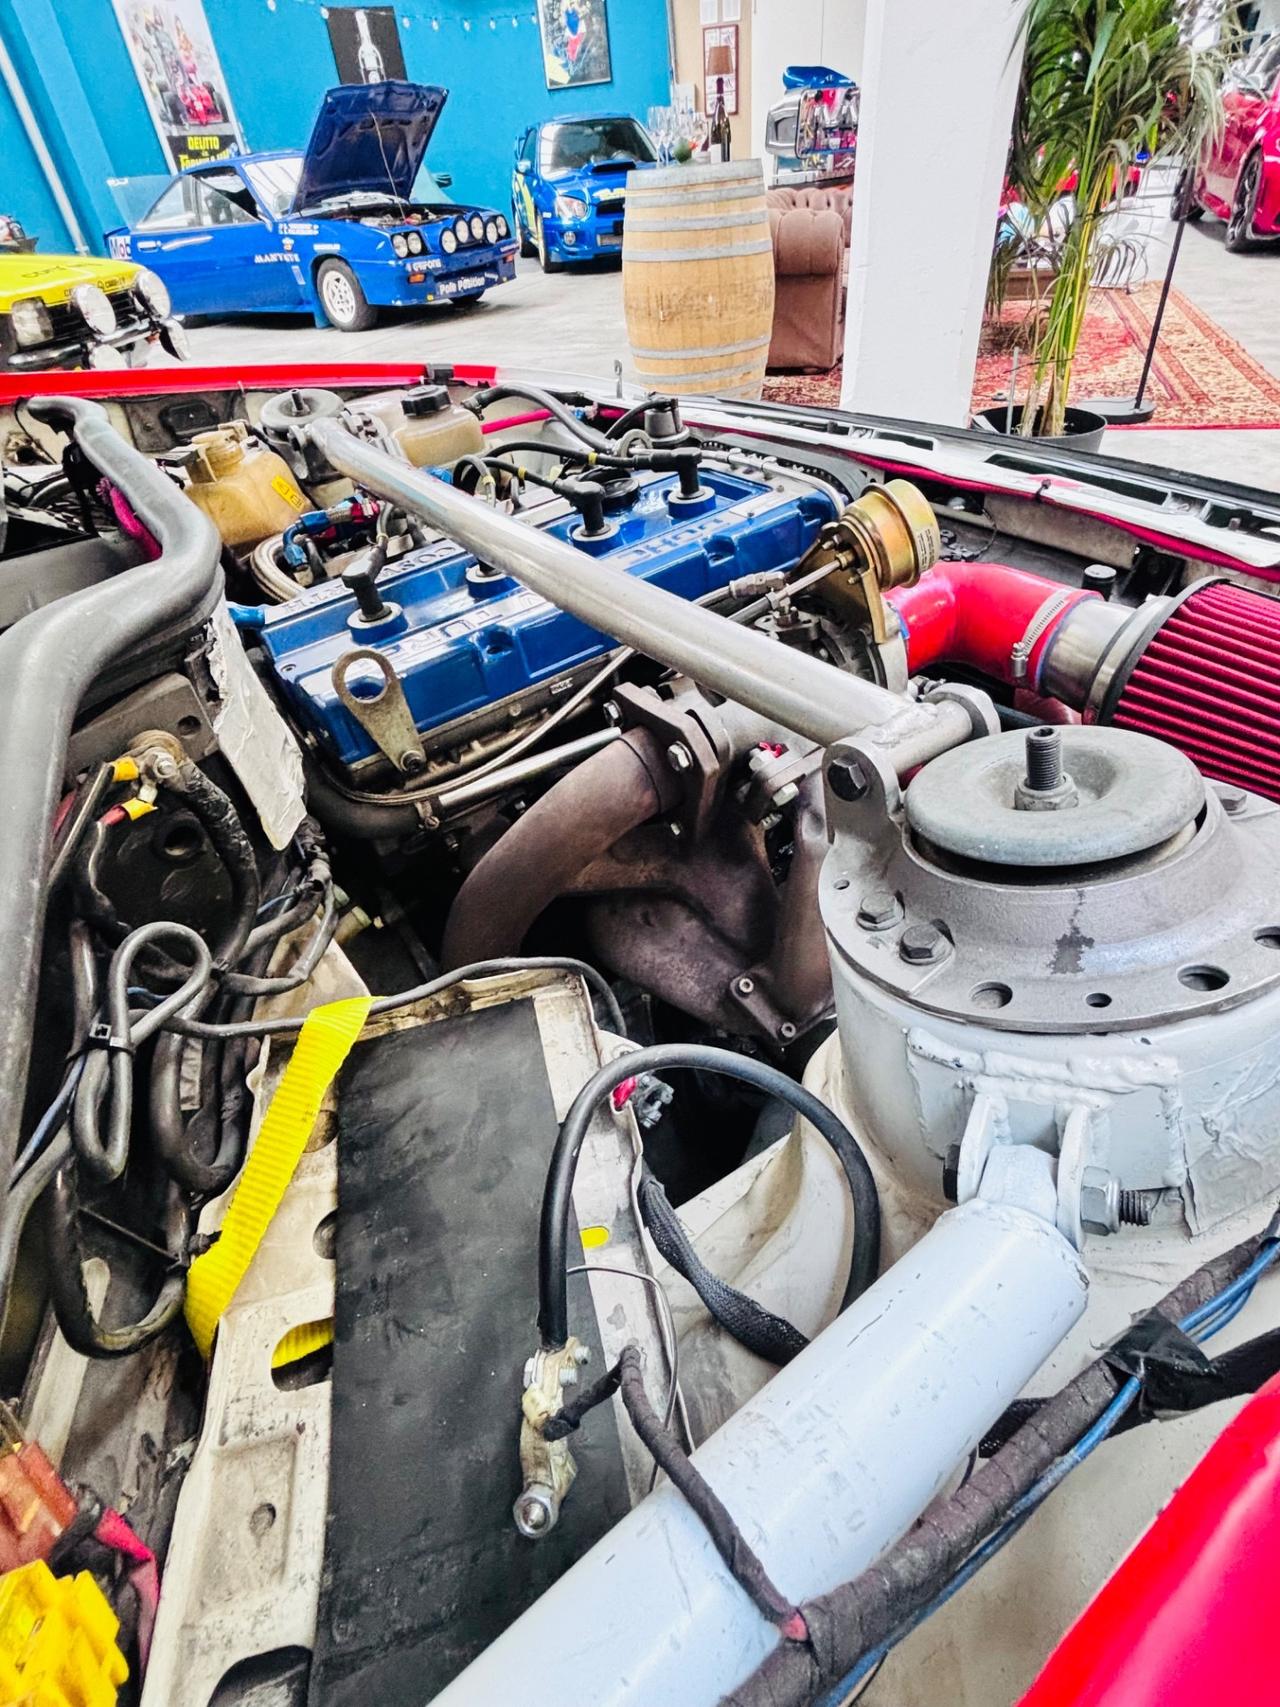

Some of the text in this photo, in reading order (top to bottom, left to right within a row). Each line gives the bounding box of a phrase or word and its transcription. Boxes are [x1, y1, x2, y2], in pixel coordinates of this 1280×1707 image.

[187, 136, 220, 150] DELITTO
[440, 282, 457, 295] Pole
[281, 546, 457, 614] COSWRTH
